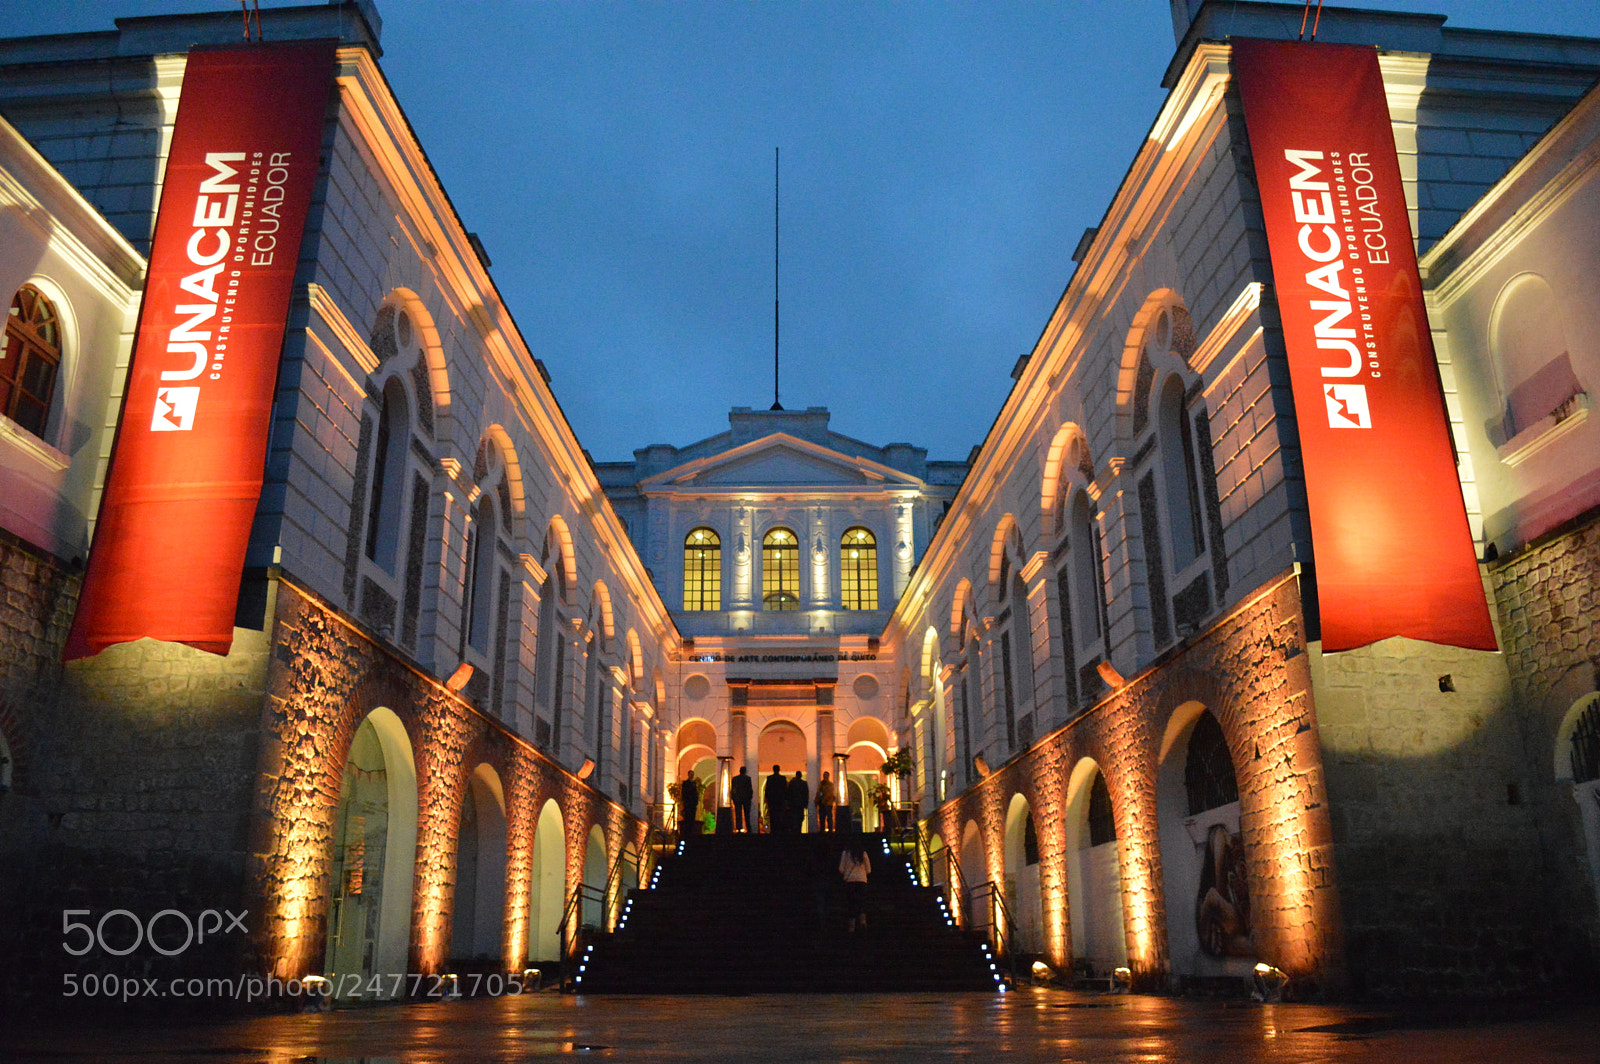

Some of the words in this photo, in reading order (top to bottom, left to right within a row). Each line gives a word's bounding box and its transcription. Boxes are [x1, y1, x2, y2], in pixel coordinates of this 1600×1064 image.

[251, 152, 292, 266] ECUADOR
[1330, 151, 1360, 260] OPORTUNIDADES
[1348, 152, 1390, 264] ECUADOR
[160, 152, 247, 381] UNACEM
[209, 270, 241, 380] CONSTRUYENDO
[234, 152, 263, 262] OPORTUNIDADES
[1284, 148, 1362, 378] UNACEM
[1352, 267, 1381, 378] CONSTRUYENDO
[724, 655, 735, 663] DE
[738, 655, 759, 663] ARTE
[851, 653, 877, 662] QUITO
